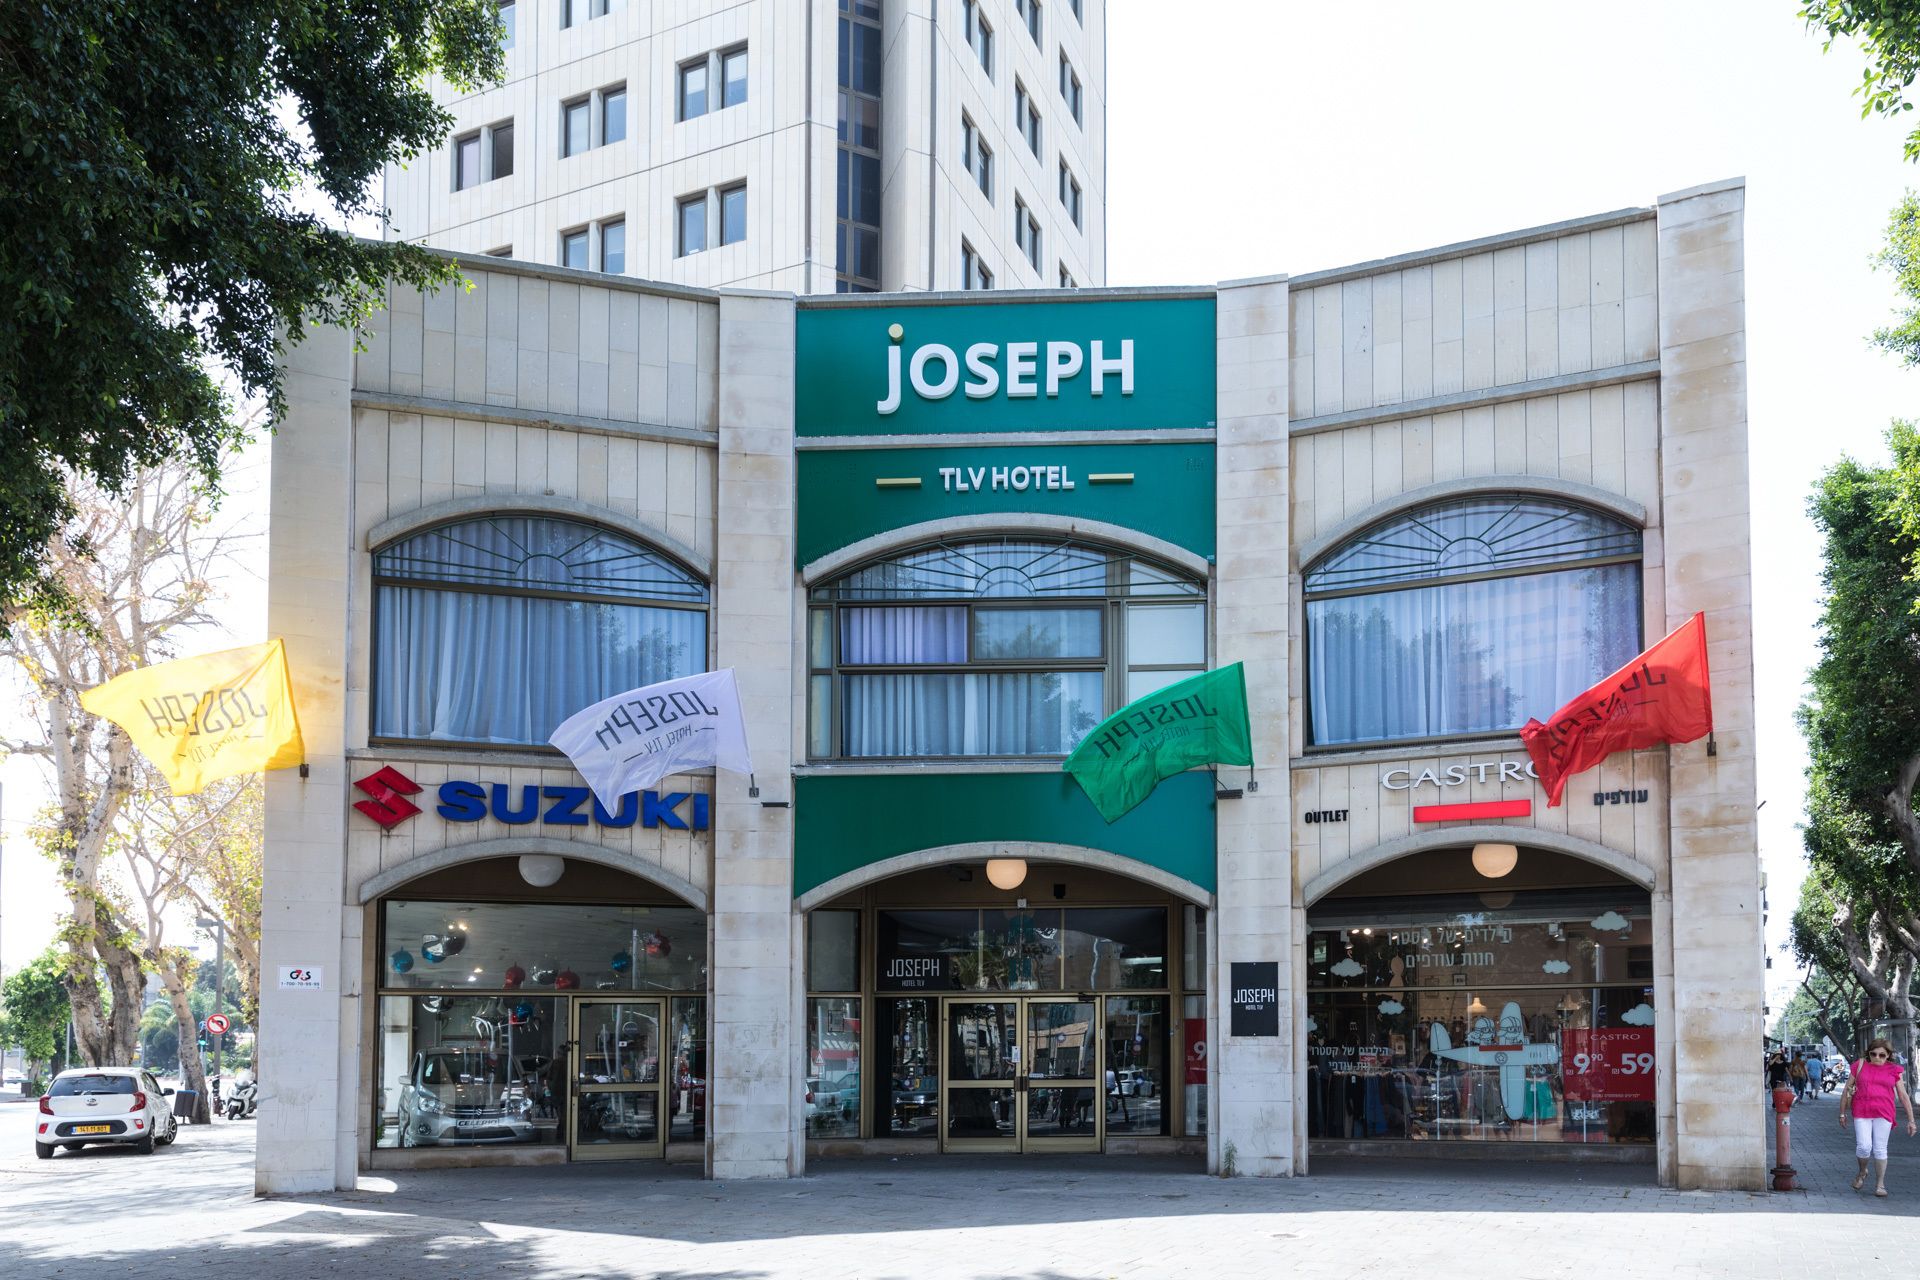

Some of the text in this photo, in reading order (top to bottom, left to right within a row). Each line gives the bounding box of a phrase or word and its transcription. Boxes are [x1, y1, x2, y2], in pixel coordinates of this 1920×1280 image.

[939, 465, 1075, 491] TLV HOTEL
[1594, 789, 1648, 805] עודפים
[436, 781, 709, 831] SUZUKI
[1304, 809, 1349, 824] OUTLET
[886, 958, 940, 977] JOSEPH
[1405, 952, 1494, 968] חנות עודפים
[1233, 988, 1275, 1003] JOSEPH
[1590, 1033, 1641, 1041] CASTRO
